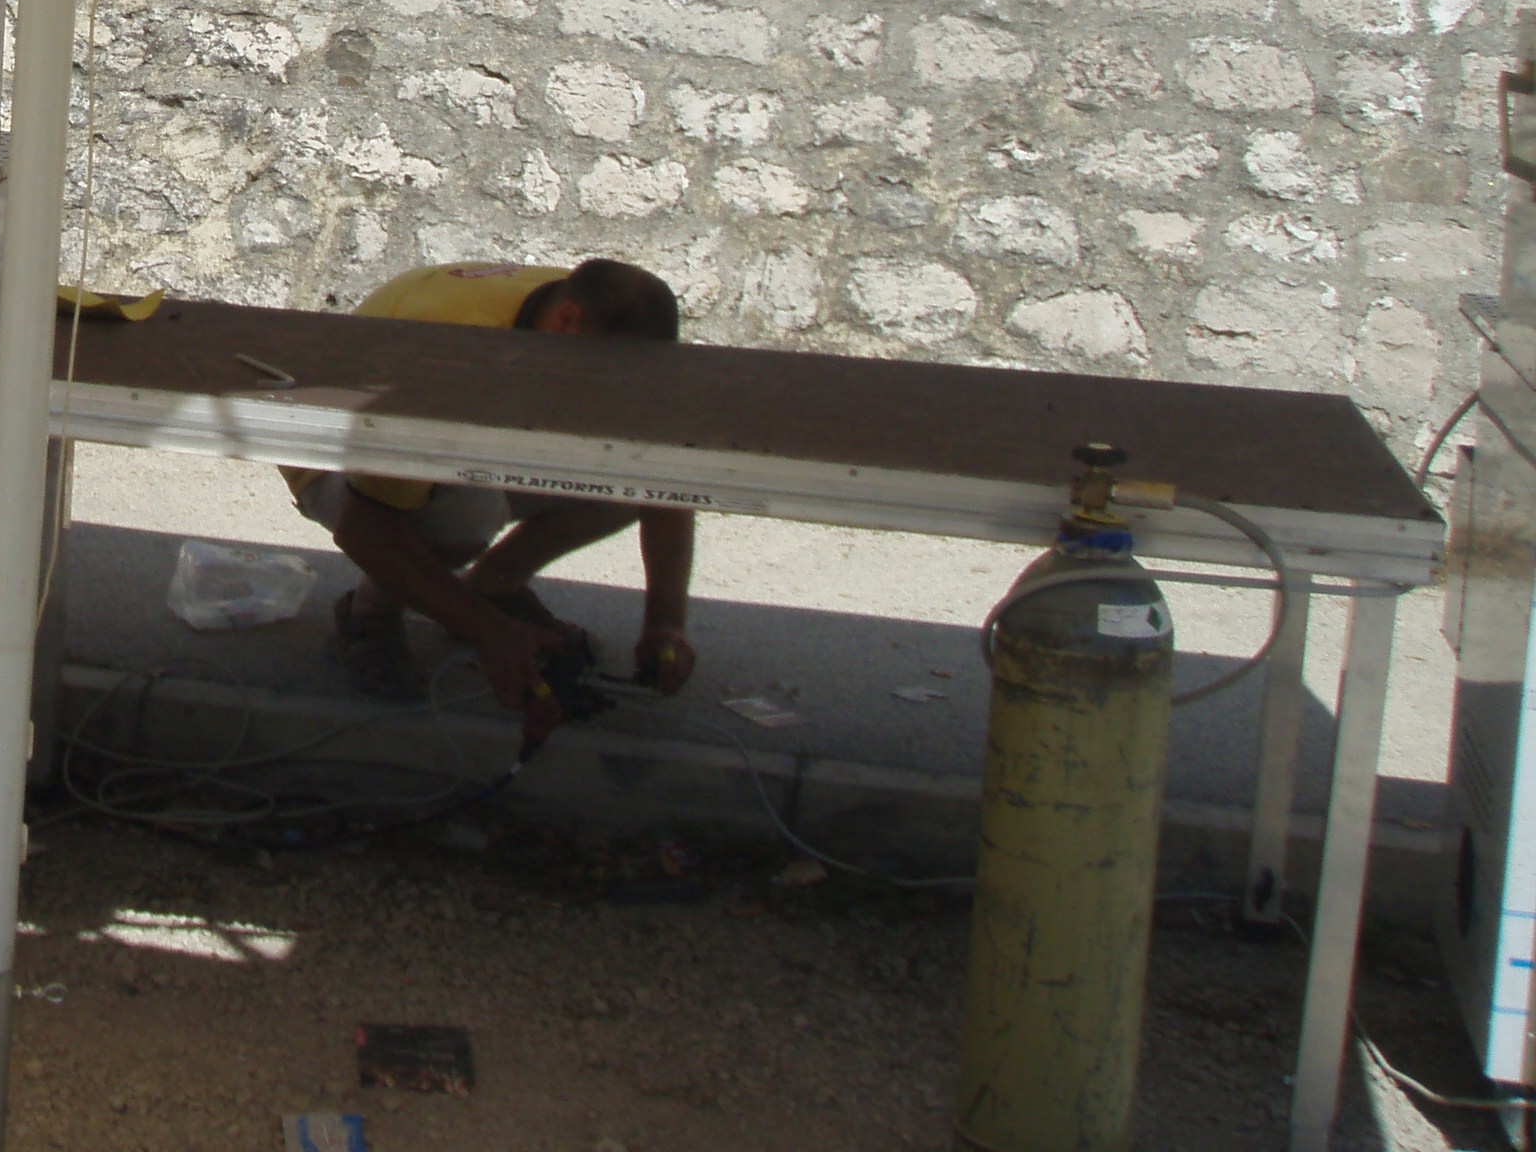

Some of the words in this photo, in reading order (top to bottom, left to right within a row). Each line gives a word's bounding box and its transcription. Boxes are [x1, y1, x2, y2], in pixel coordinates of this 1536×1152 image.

[504, 474, 615, 496] PLATFORMS
[623, 486, 636, 497] &
[644, 489, 714, 505] STAGES
